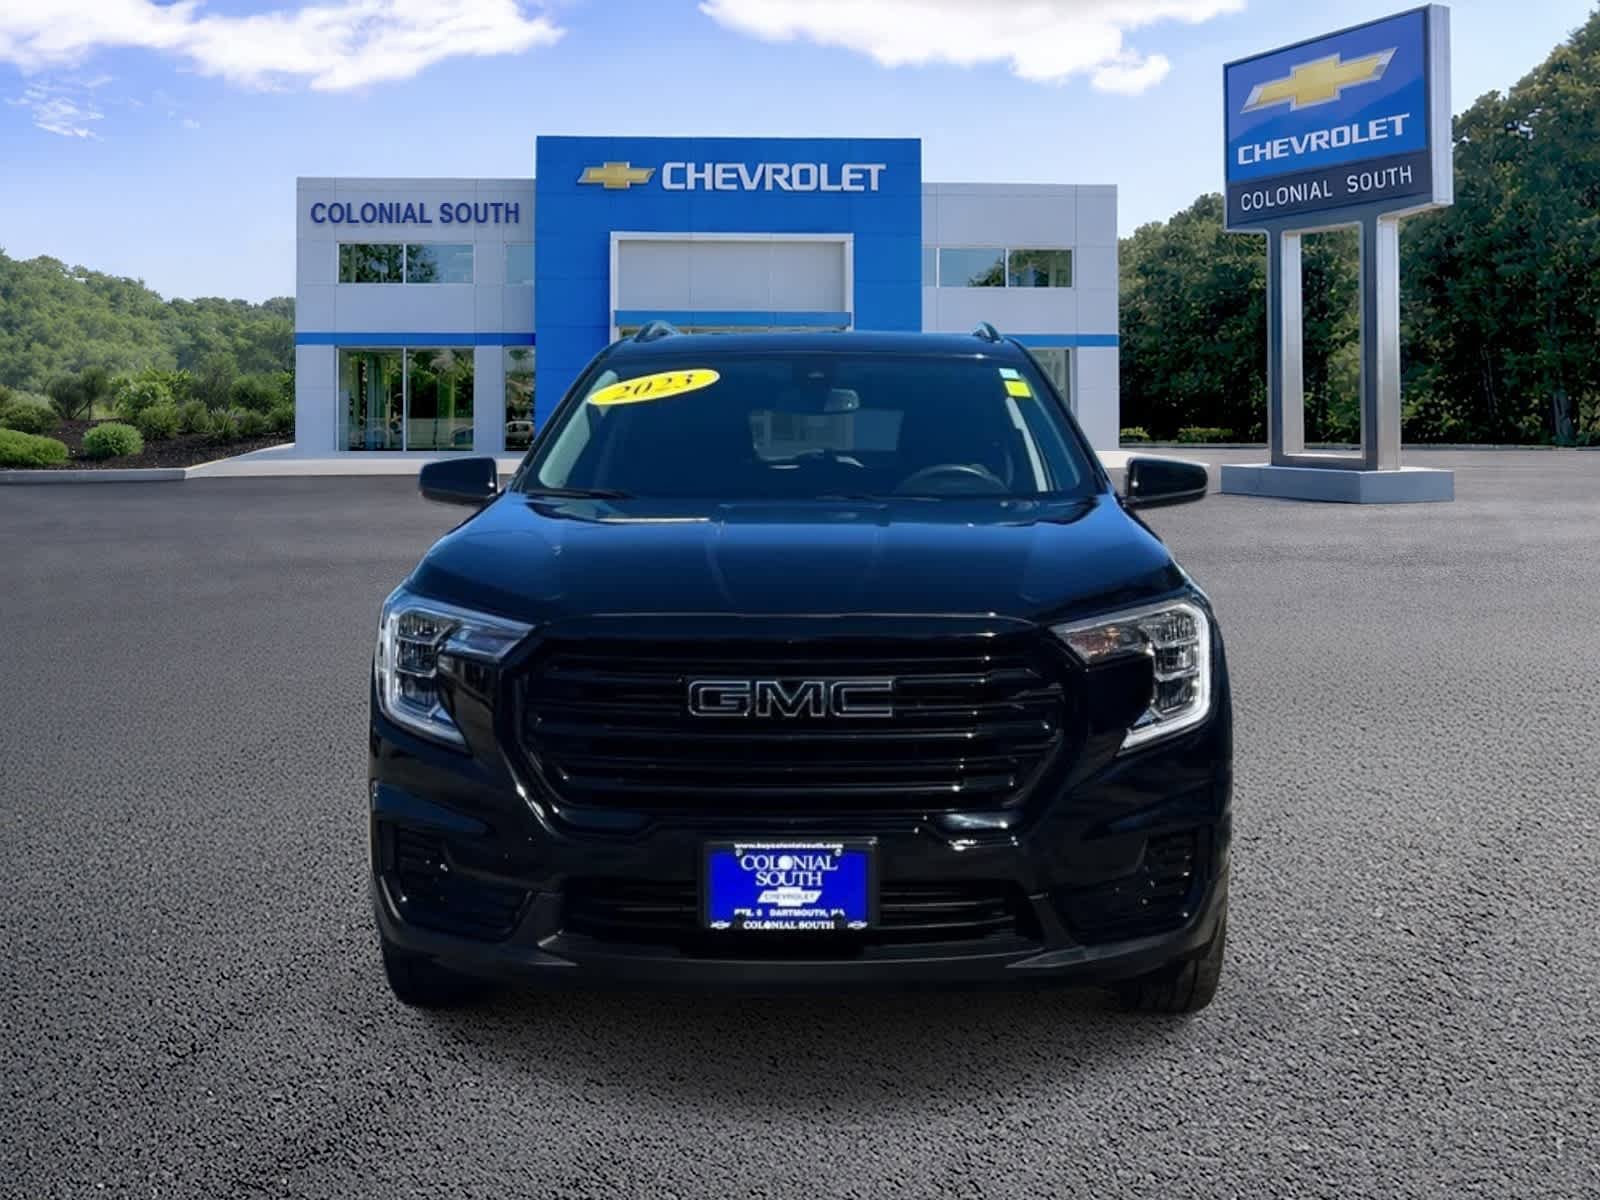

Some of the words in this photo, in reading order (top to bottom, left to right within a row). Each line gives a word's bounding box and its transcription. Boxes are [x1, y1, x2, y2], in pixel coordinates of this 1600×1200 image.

[1238, 113, 1410, 165] CHEVROLET
[662, 162, 886, 191] CHEVROLET
[1241, 180, 1333, 211] COLONIAL
[1346, 166, 1413, 194] SOUTH
[310, 202, 433, 224] COLONIAL
[439, 202, 520, 224] SOUTH
[613, 373, 695, 400] 2023
[688, 680, 893, 717] GMC
[740, 855, 839, 871] COLONIAL
[755, 872, 823, 886] SOUTH
[743, 921, 797, 930] COLONIAL
[798, 921, 835, 930] SOUTH
